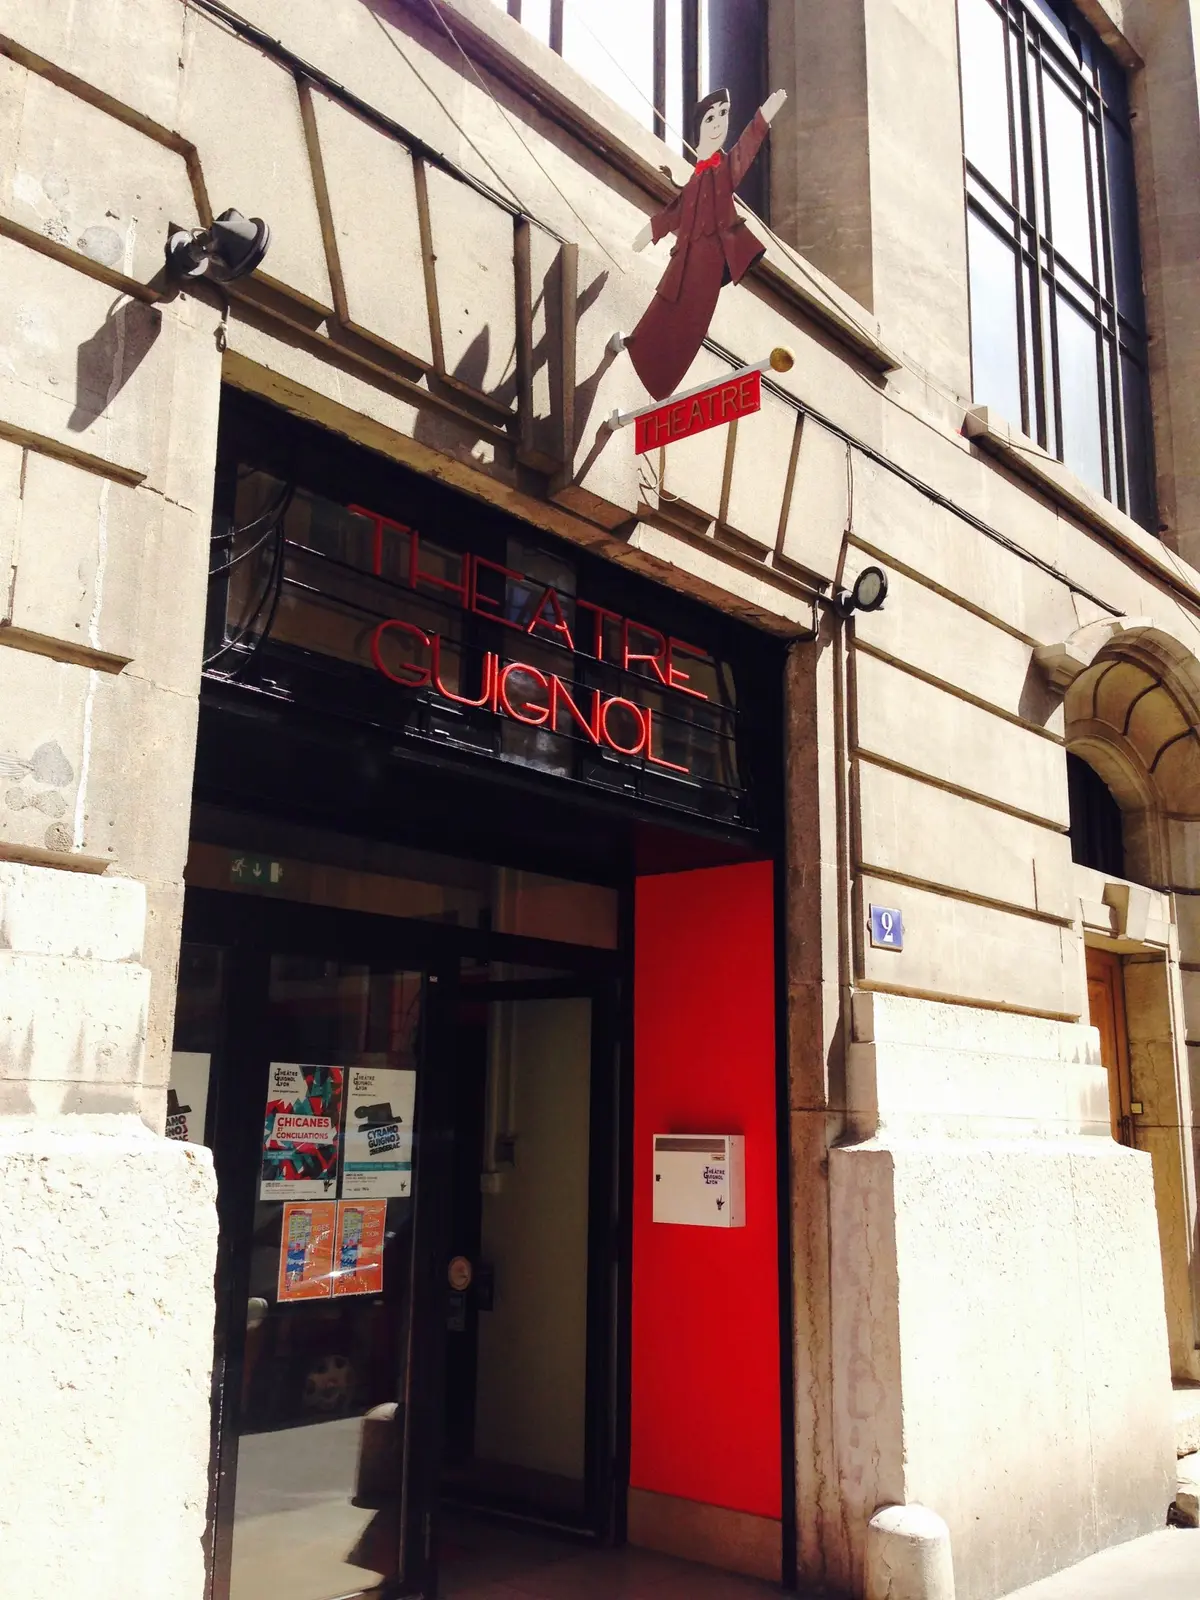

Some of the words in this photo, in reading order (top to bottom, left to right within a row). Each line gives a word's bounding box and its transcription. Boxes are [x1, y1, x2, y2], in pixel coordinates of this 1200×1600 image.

[637, 377, 757, 446] THEATRE
[347, 502, 709, 699] THEATRE
[369, 618, 690, 773] GUIGNOL
[277, 1117, 330, 1128] CHICANES
